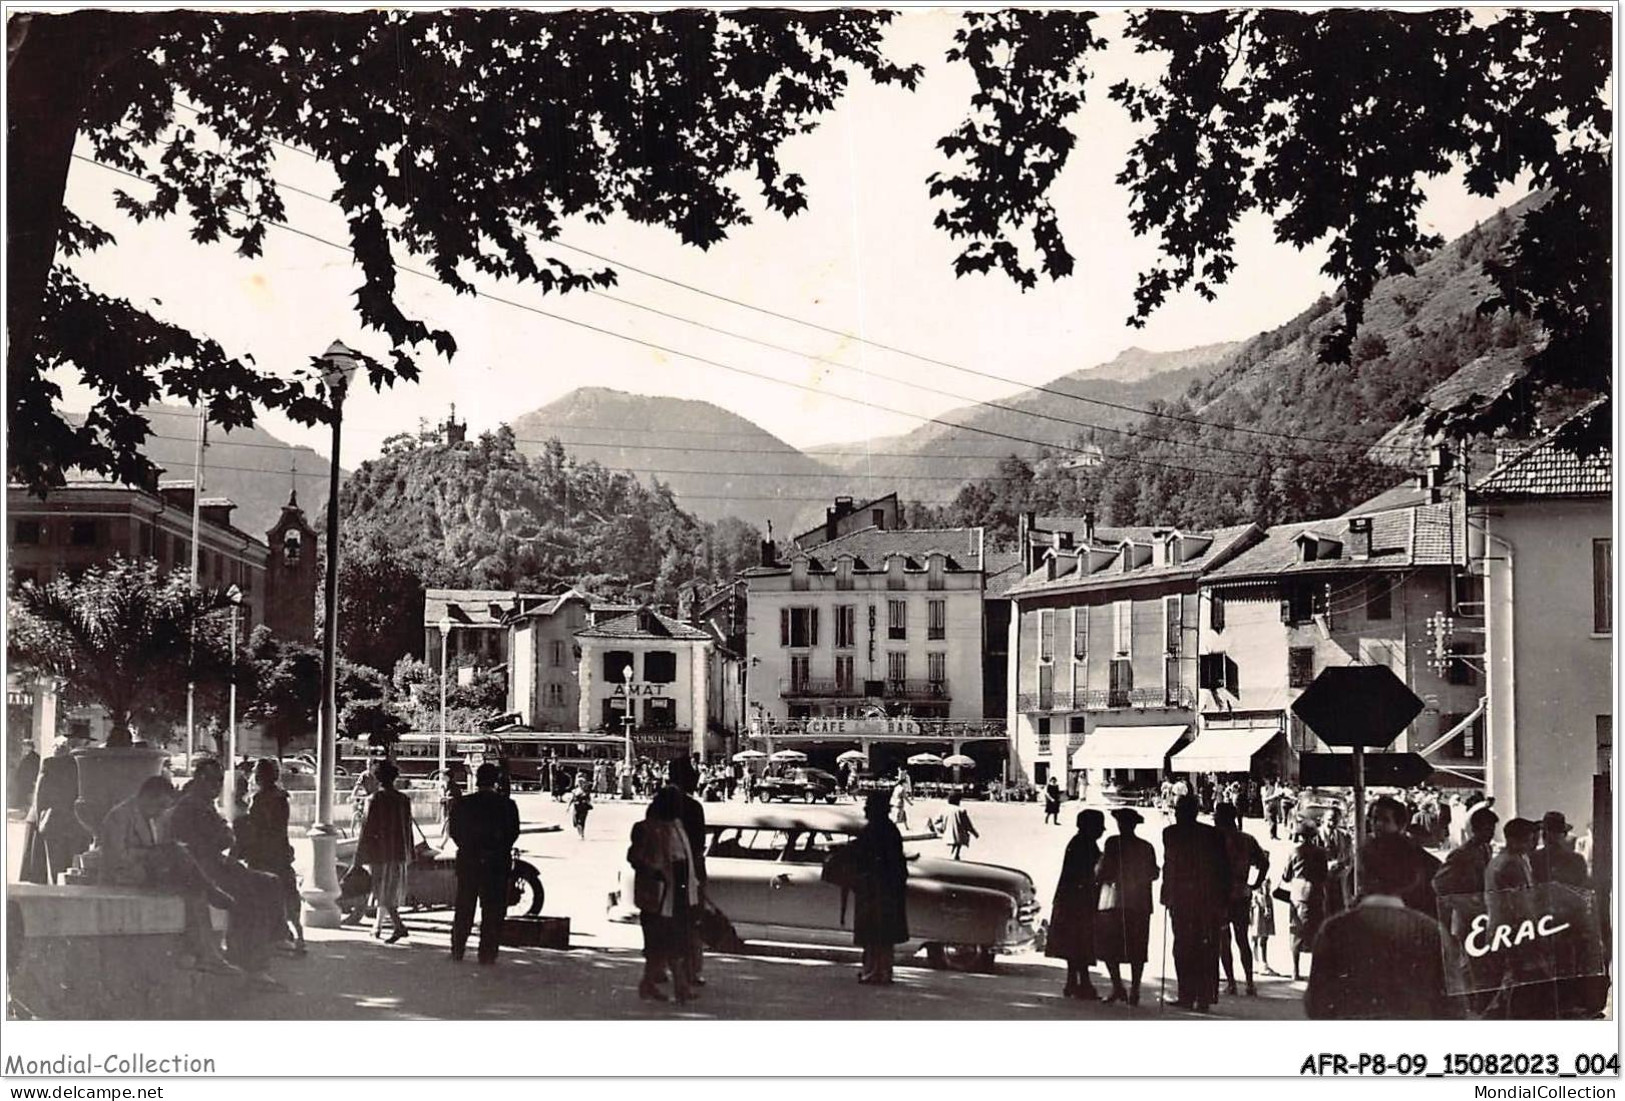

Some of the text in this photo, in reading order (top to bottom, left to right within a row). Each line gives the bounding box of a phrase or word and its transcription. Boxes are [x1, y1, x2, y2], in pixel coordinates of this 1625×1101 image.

[868, 605, 876, 662] HOTEL
[614, 684, 666, 696] AMAT
[813, 721, 914, 734] CAFE BAR
